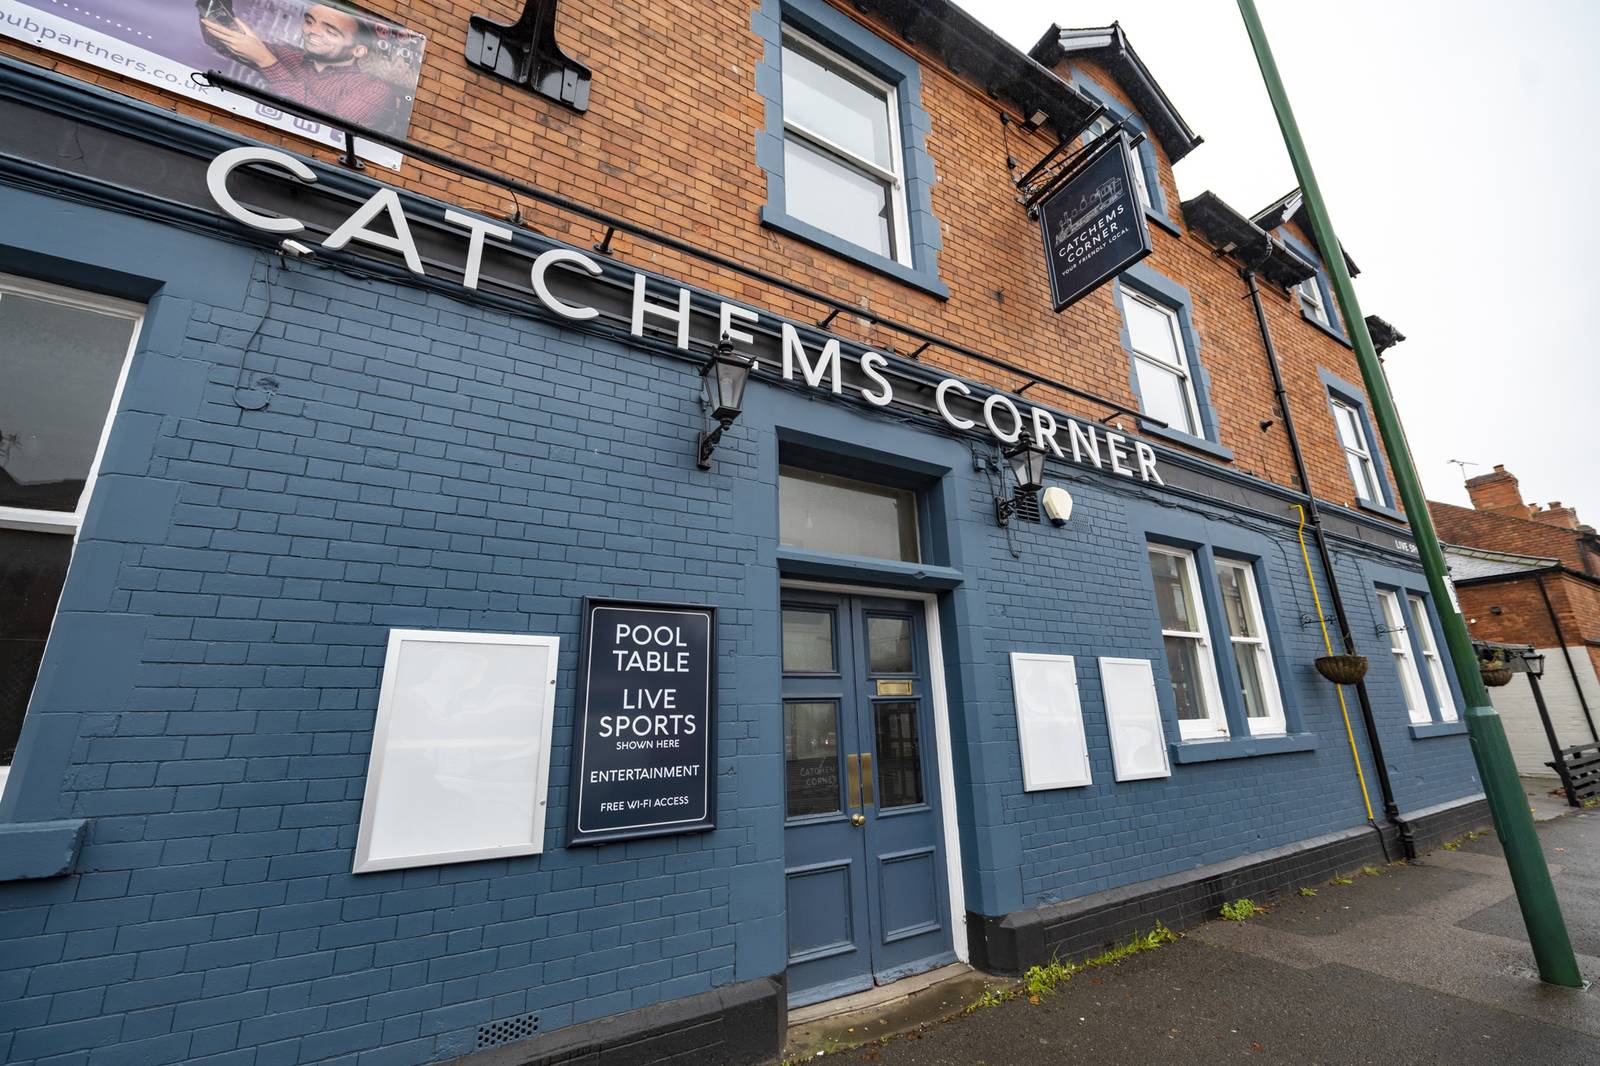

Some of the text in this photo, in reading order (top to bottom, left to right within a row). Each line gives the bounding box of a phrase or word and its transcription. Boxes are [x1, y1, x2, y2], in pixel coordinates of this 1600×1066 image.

[1059, 204, 1124, 257] CATCHEMS
[1062, 227, 1129, 276] YOUR FRIENDLY LOCAL
[1067, 222, 1118, 263] CORNER
[206, 146, 1166, 486] CATCHEMS CORNER
[615, 623, 688, 647] POOL
[612, 650, 690, 673] TABLE
[623, 688, 677, 710] LIVE
[598, 714, 696, 737] SPORTS
[616, 739, 680, 750] SHOWN HERE
[590, 764, 700, 783] ENTERTAINMENT
[600, 795, 689, 812] FREE WI-FI ACCESS
